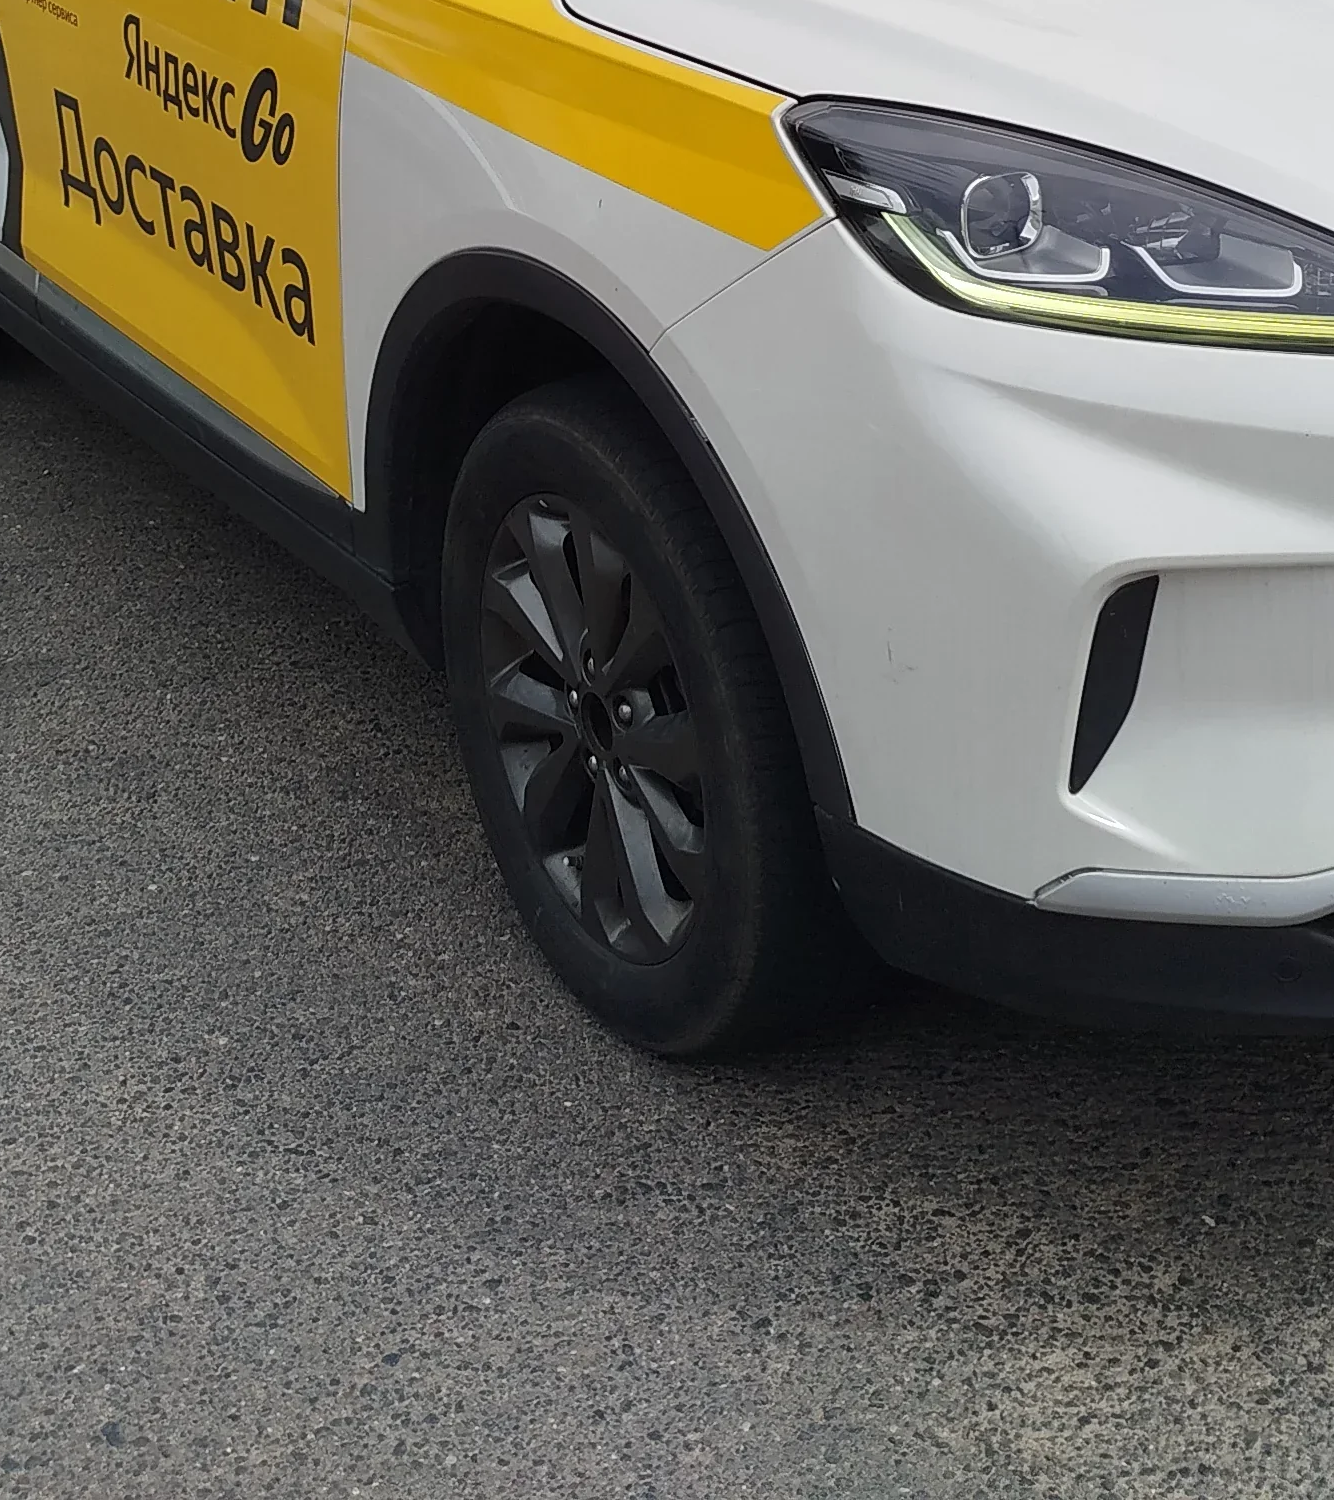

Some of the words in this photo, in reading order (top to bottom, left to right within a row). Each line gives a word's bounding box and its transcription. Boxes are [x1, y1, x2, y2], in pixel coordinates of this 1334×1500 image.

[48, 1, 79, 27] сервиса
[122, 13, 237, 140] Яндекс
[240, 67, 295, 166] Go
[53, 87, 316, 347] Доставка
